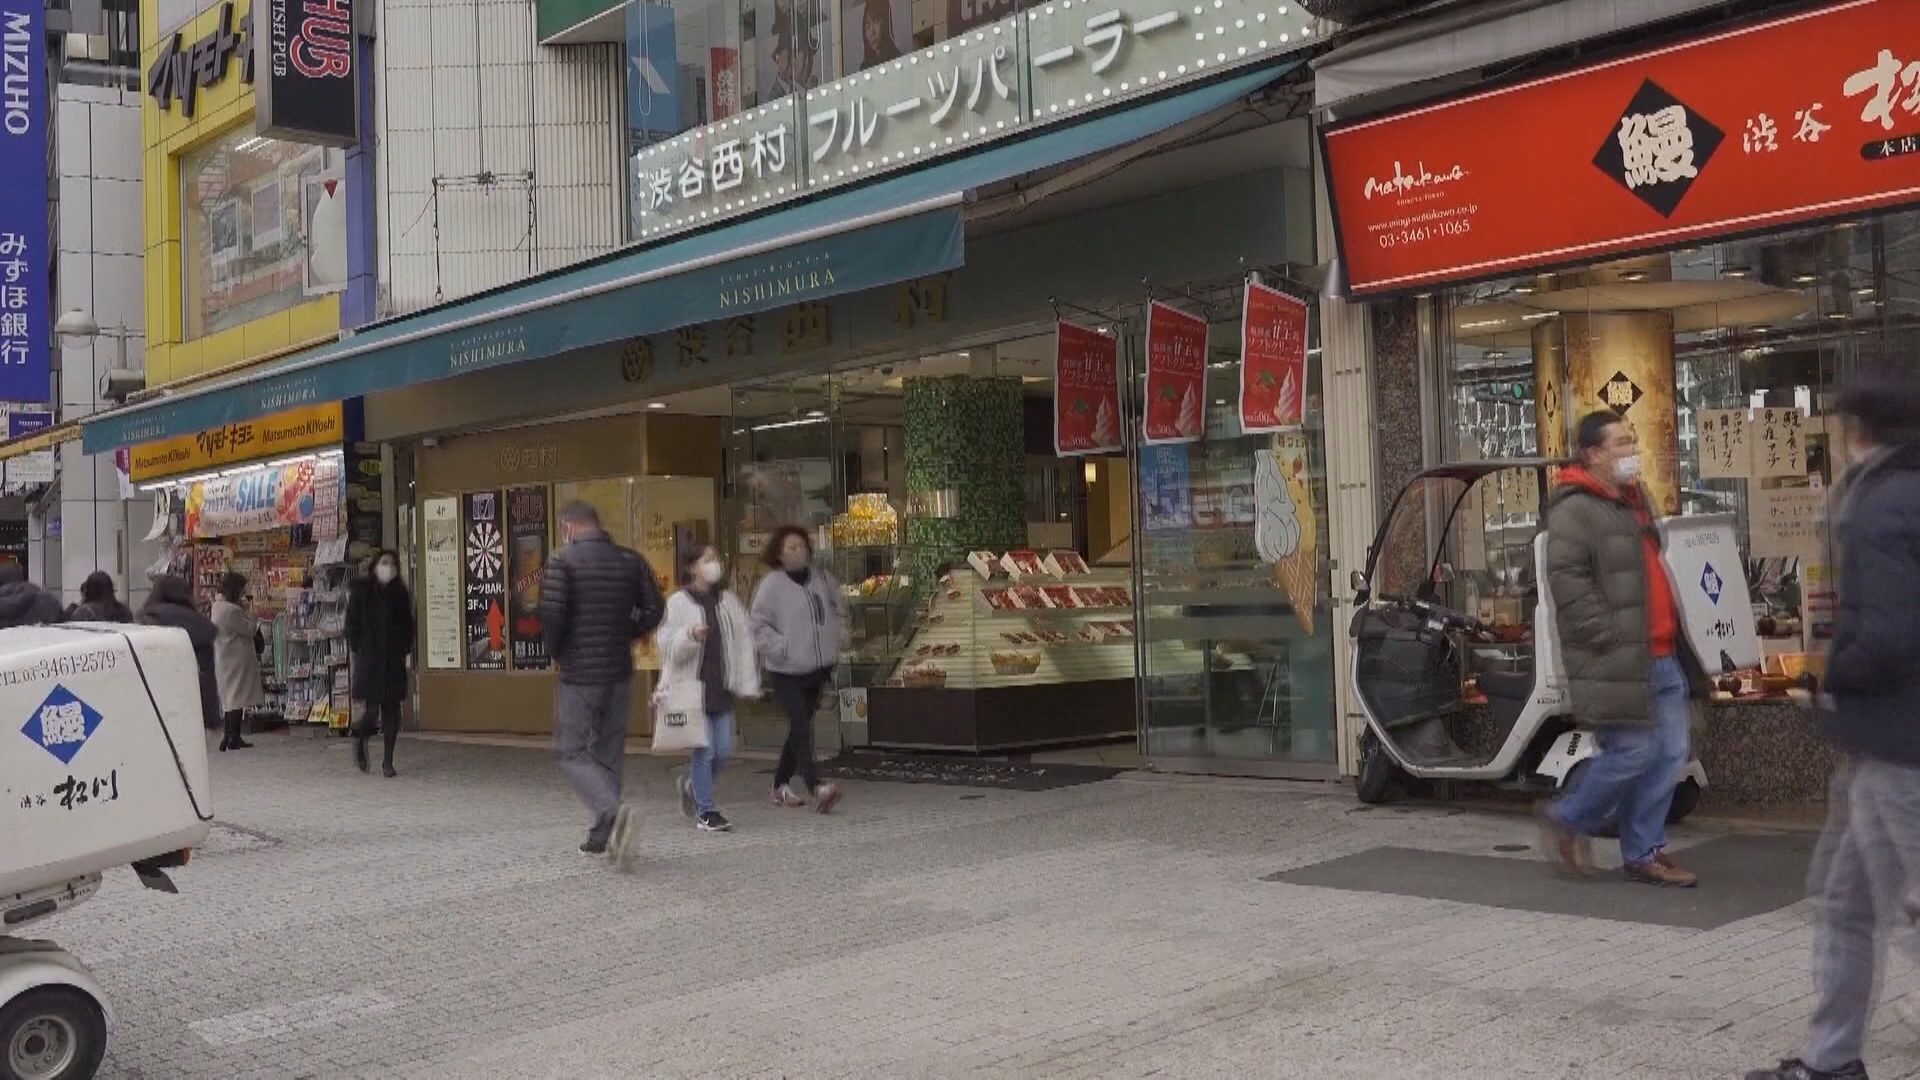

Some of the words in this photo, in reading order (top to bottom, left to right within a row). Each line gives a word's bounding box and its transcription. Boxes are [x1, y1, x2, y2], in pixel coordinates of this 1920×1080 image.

[272, 0, 287, 37] ISH
[289, 0, 351, 78] HUB
[3, 11, 31, 135] MIZUHO
[273, 40, 287, 77] PUB
[647, 123, 787, 210] 渋谷西村
[809, 9, 1180, 163] フルーツパーラー
[1743, 102, 1832, 154] 渋谷
[1880, 136, 1918, 157] 本店
[0, 232, 30, 366] みずほ銀行
[718, 267, 836, 309] NISHIMURA
[450, 338, 526, 369] NISHIMURA
[236, 470, 279, 513] SALE
[22, 649, 116, 683] 03-3461-2579
